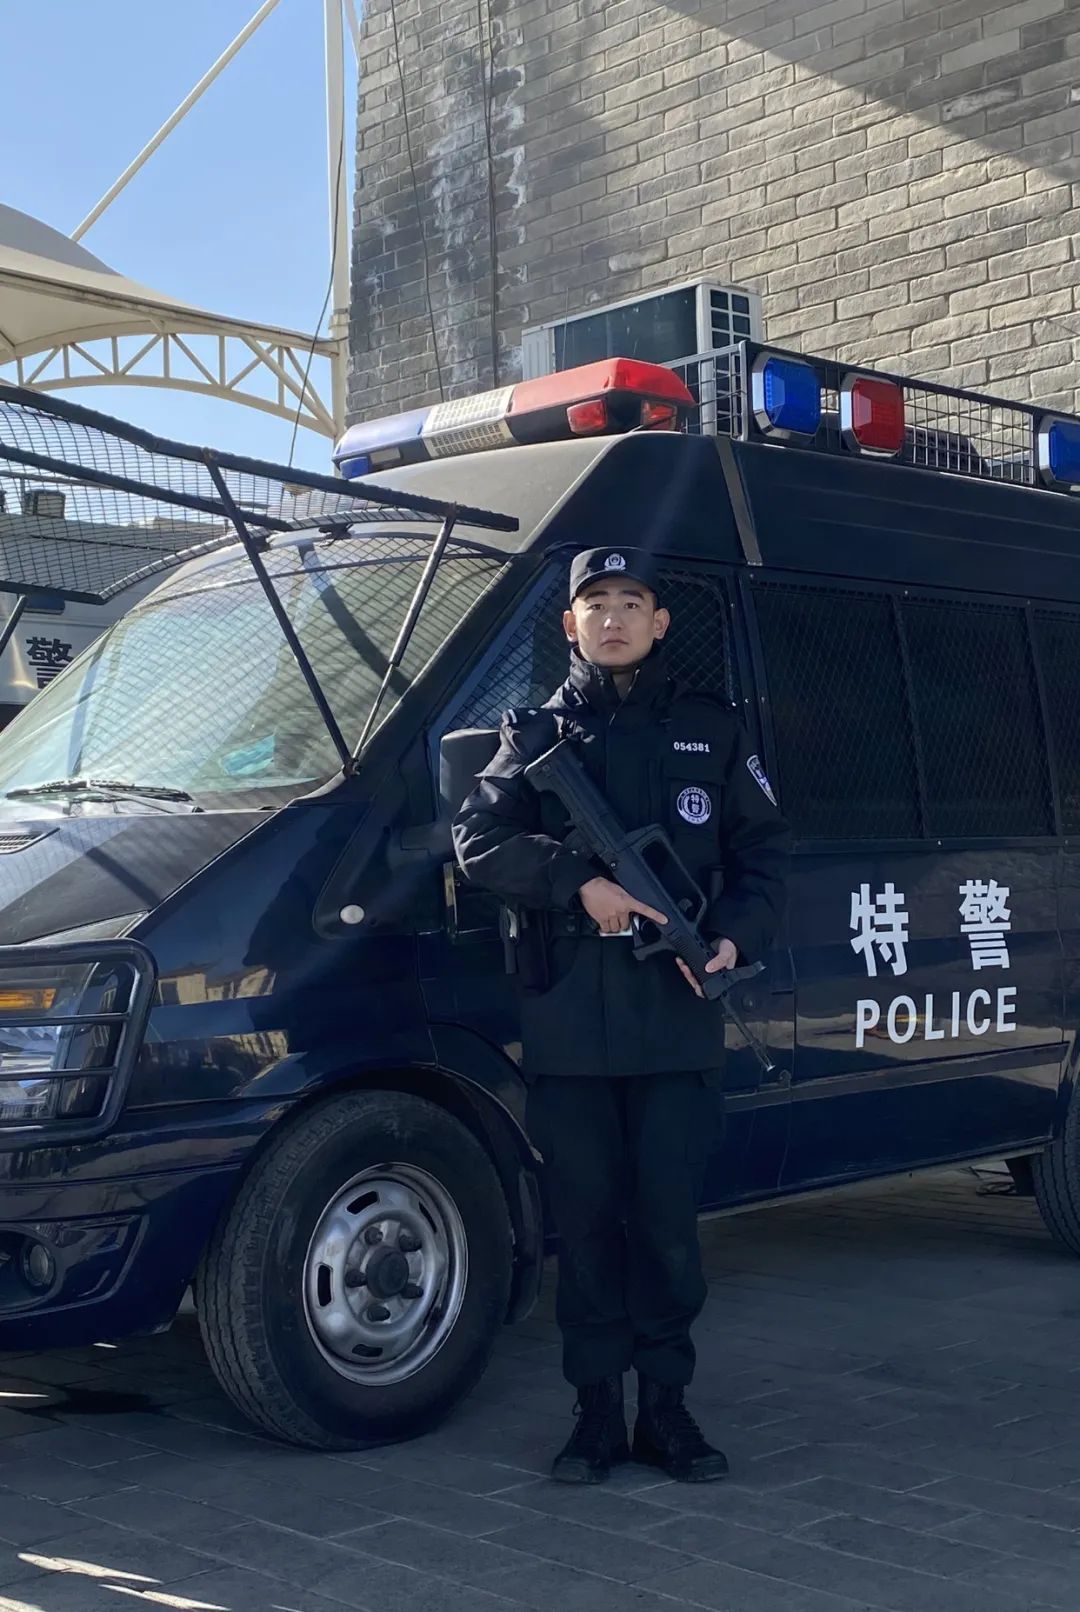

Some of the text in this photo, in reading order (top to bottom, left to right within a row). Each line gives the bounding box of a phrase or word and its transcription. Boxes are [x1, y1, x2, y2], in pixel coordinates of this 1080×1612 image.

[673, 741, 710, 753] 054381
[850, 879, 1011, 977] 特警
[856, 987, 1017, 1048] POLICE
